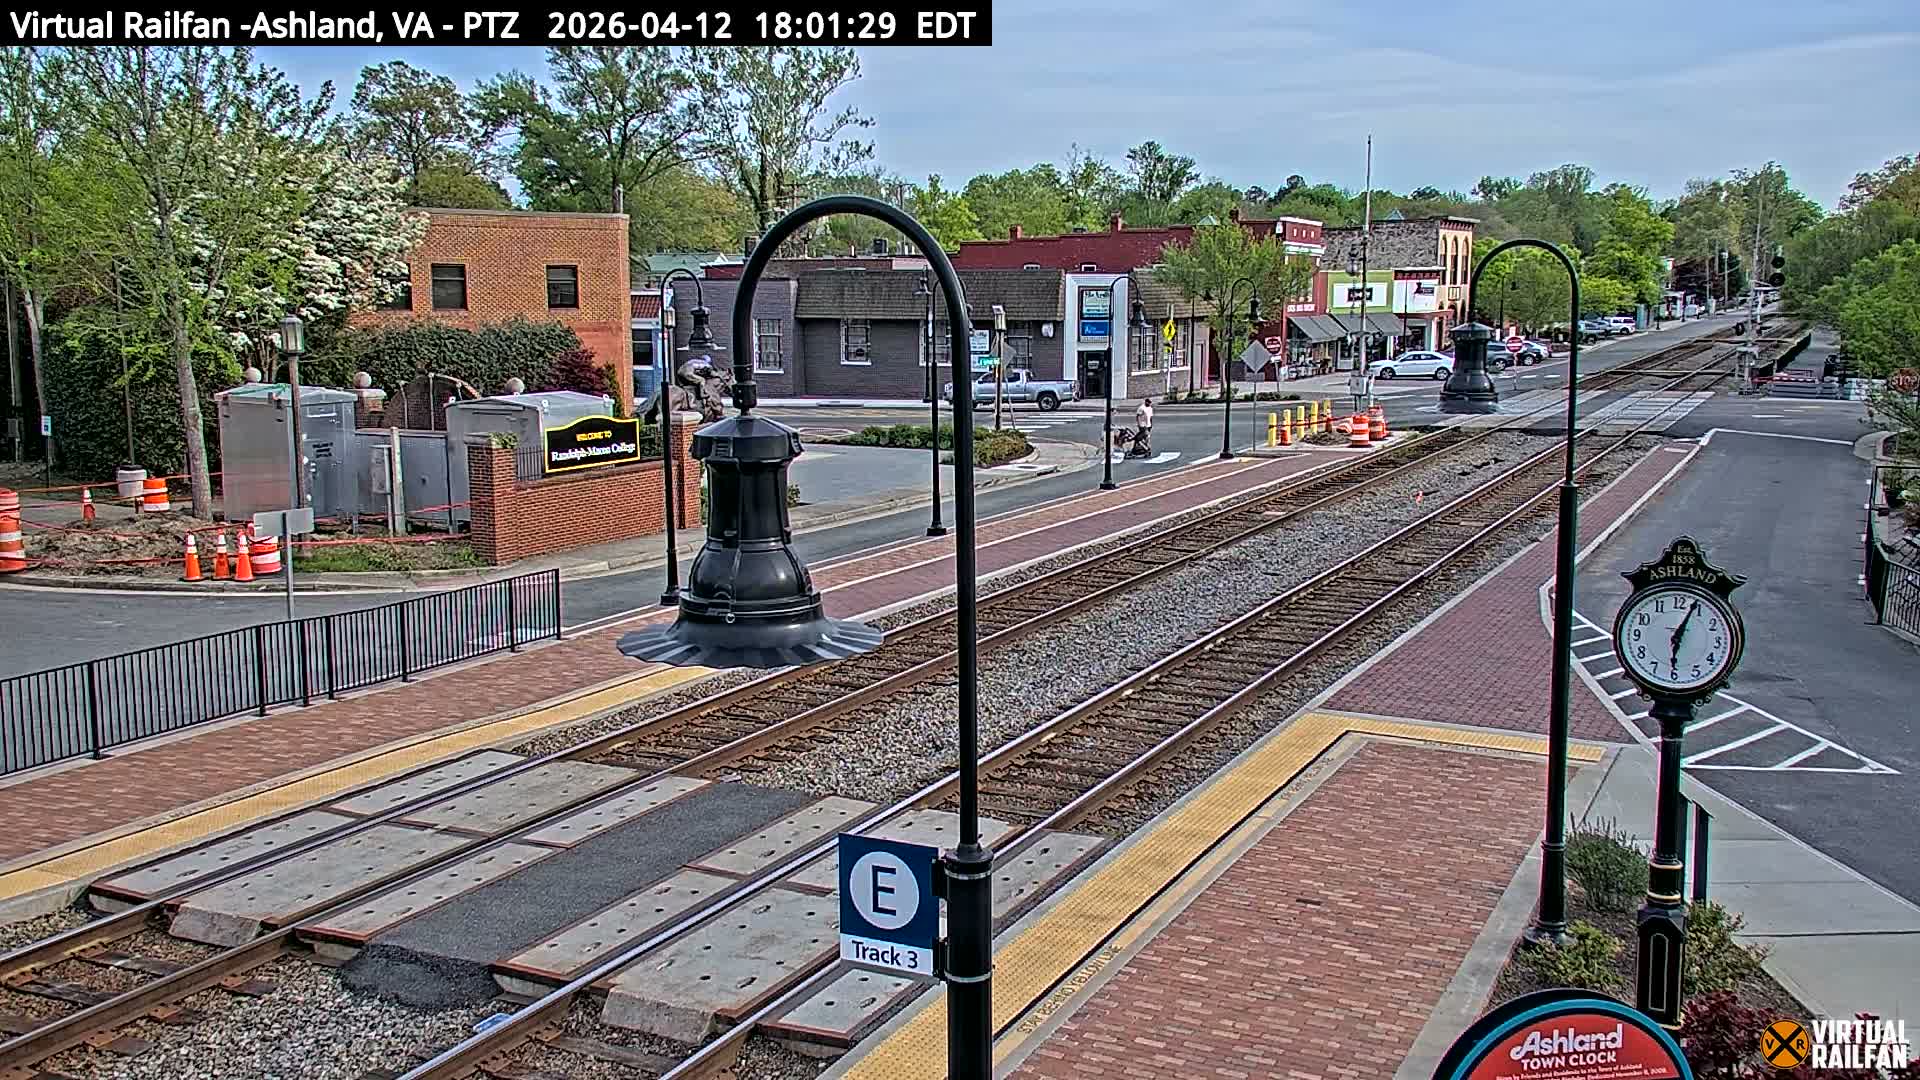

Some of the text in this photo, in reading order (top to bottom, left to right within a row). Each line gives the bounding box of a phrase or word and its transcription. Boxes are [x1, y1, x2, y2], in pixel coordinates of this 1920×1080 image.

[1891, 375, 1918, 386] STOP
[576, 430, 612, 441] WELCOME TO
[551, 442, 636, 461] Randolph-Macon College
[1673, 555, 1695, 564] 1858
[1650, 566, 1716, 583] ASHLAND
[1673, 596, 1686, 610] 12
[1696, 604, 1702, 616] 1
[1638, 612, 1650, 625] 10
[1709, 618, 1717, 632] 2
[1633, 629, 1641, 641] 9
[1714, 637, 1722, 649] 3
[1637, 646, 1646, 659] 8
[1706, 652, 1715, 665] 4
[1650, 662, 1658, 674] 7
[1670, 668, 1678, 680] 6
[1691, 665, 1701, 678] 5
[872, 865, 896, 916] E
[852, 940, 918, 968] Track 3
[1510, 1023, 1623, 1060] Ashland
[1521, 1051, 1616, 1070] TOWN CLOCK
